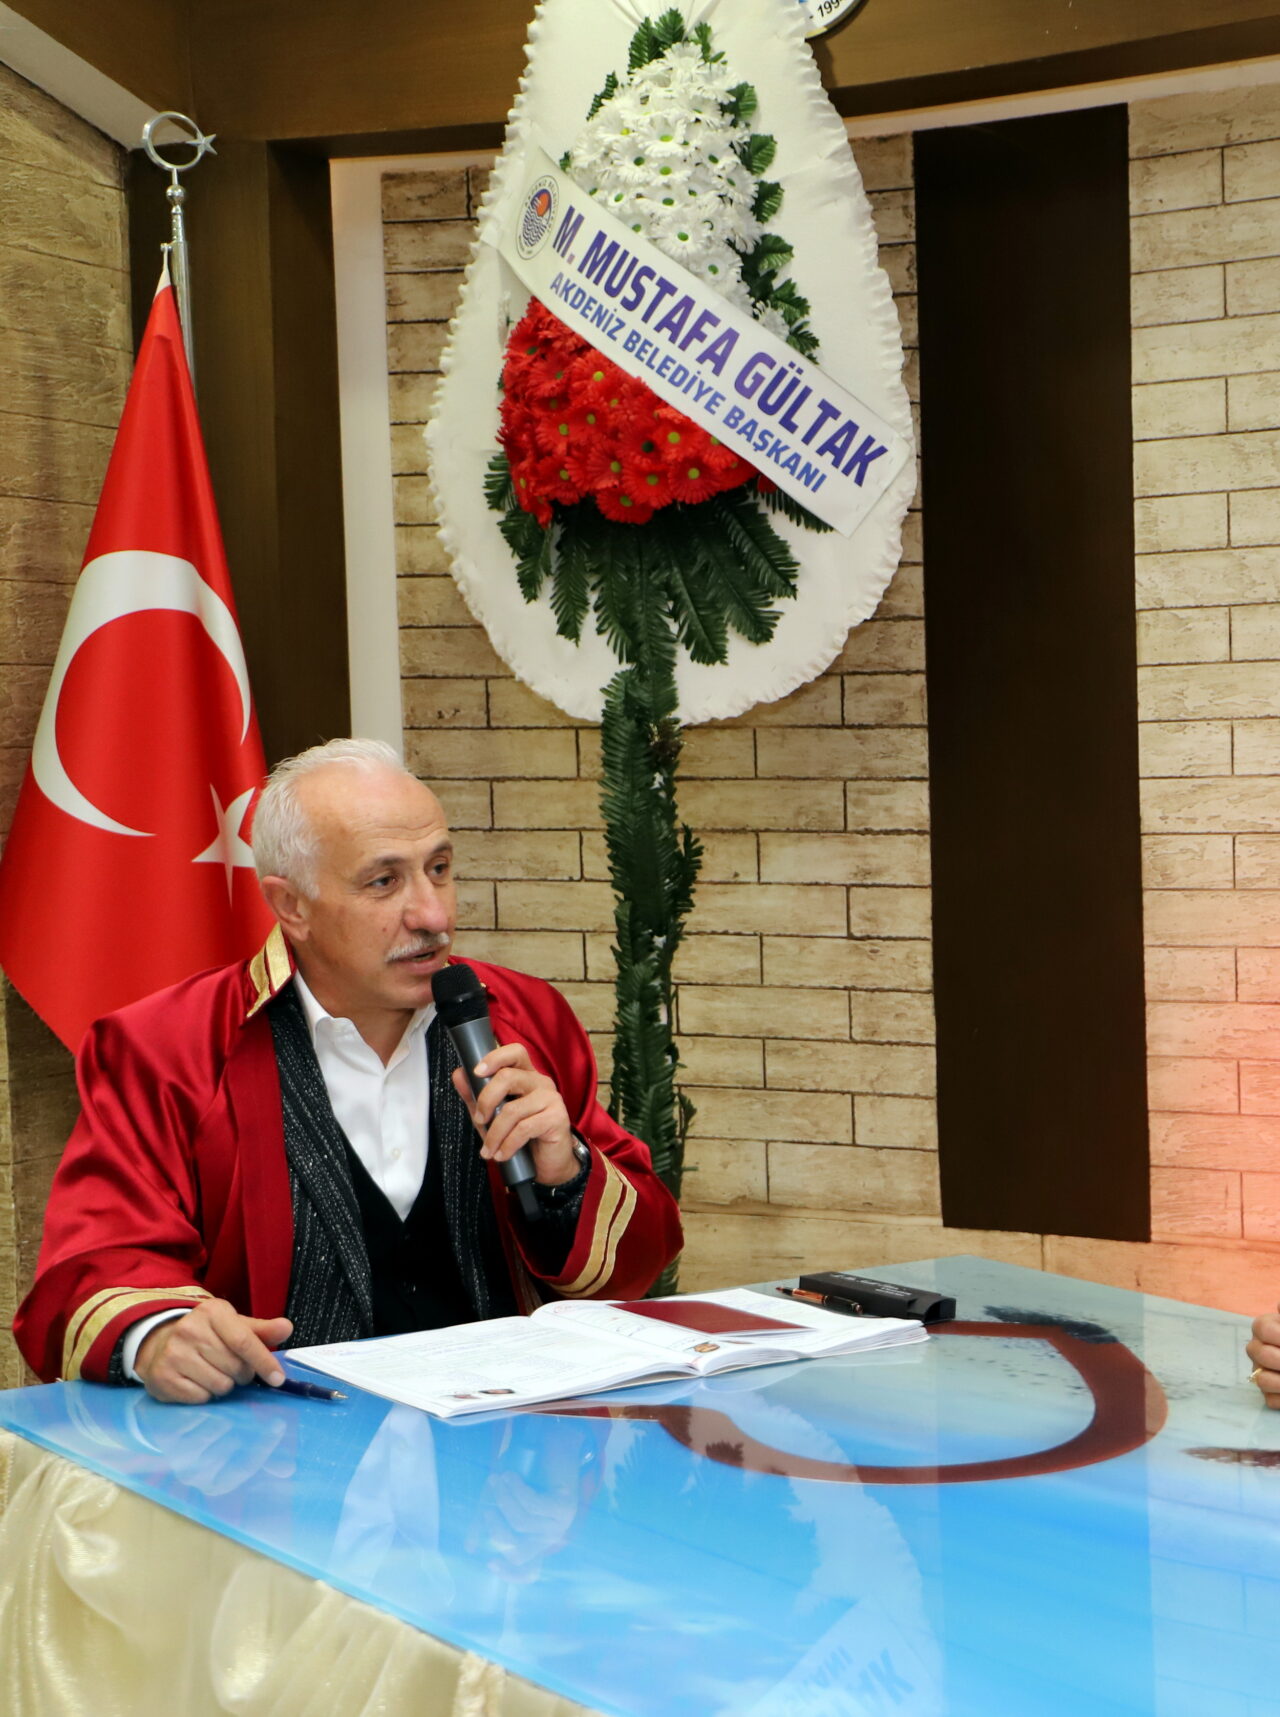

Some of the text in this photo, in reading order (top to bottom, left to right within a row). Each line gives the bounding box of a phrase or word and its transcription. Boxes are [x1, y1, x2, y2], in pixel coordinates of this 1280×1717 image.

[550, 272, 827, 493] AKDENİZ BELEDİYE BAŞKANI
[552, 205, 889, 488] M. MUSTAFA GÜLTAK
